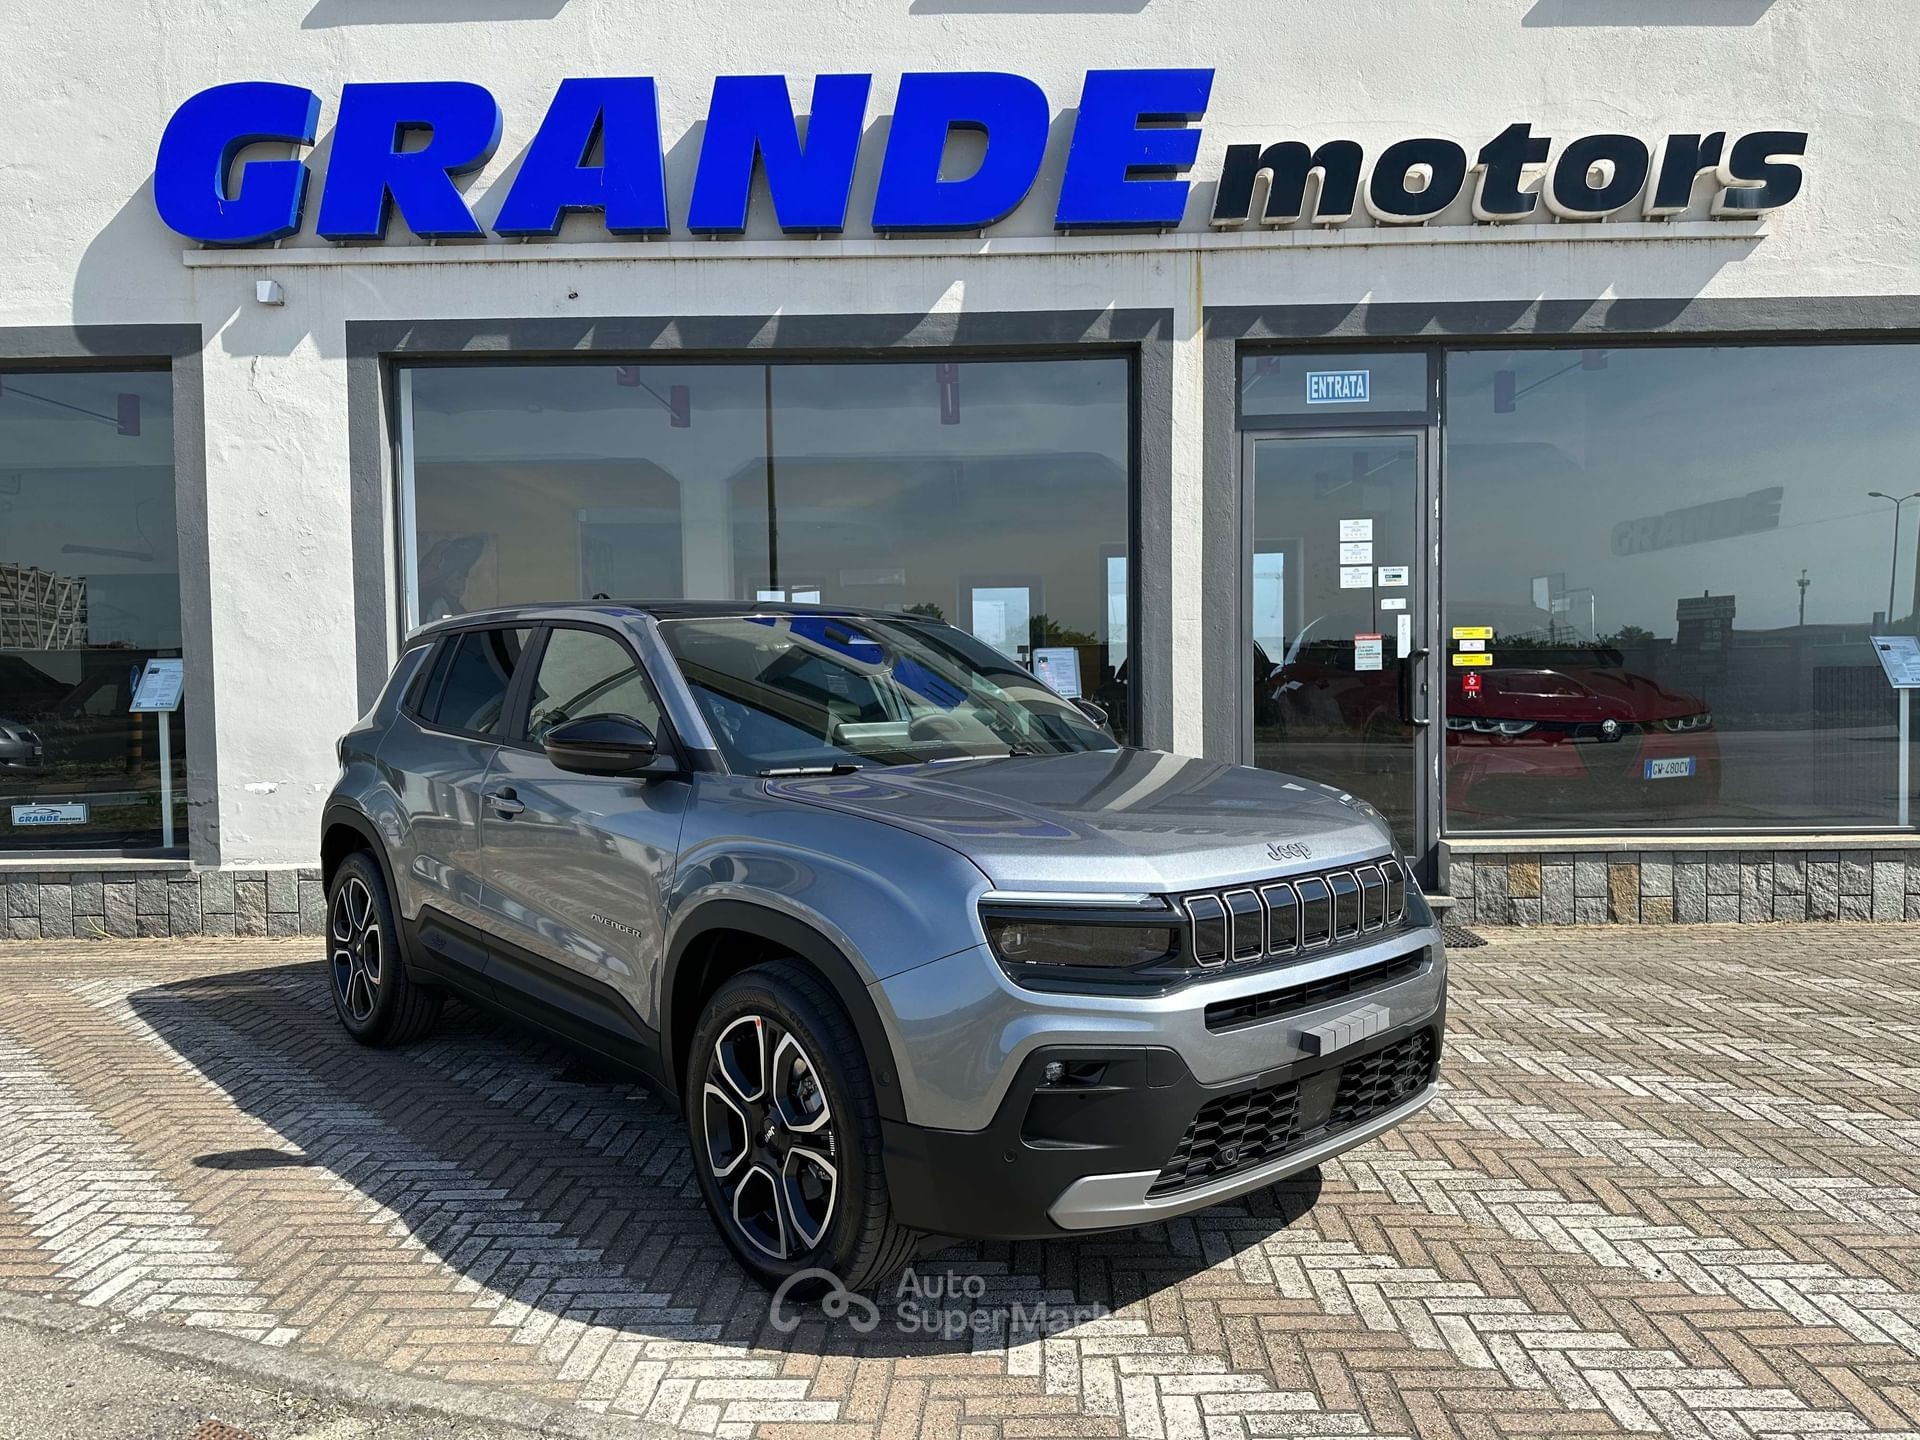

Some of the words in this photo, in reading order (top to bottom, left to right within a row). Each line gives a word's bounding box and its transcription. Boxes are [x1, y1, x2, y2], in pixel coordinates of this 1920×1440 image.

[154, 68, 1215, 245] GRANDE
[1210, 123, 1808, 225] motors
[1311, 375, 1365, 398] ENTRATA
[18, 815, 59, 823] GRANDE
[1266, 842, 1312, 861] Jeep
[591, 913, 641, 938] AVENGER
